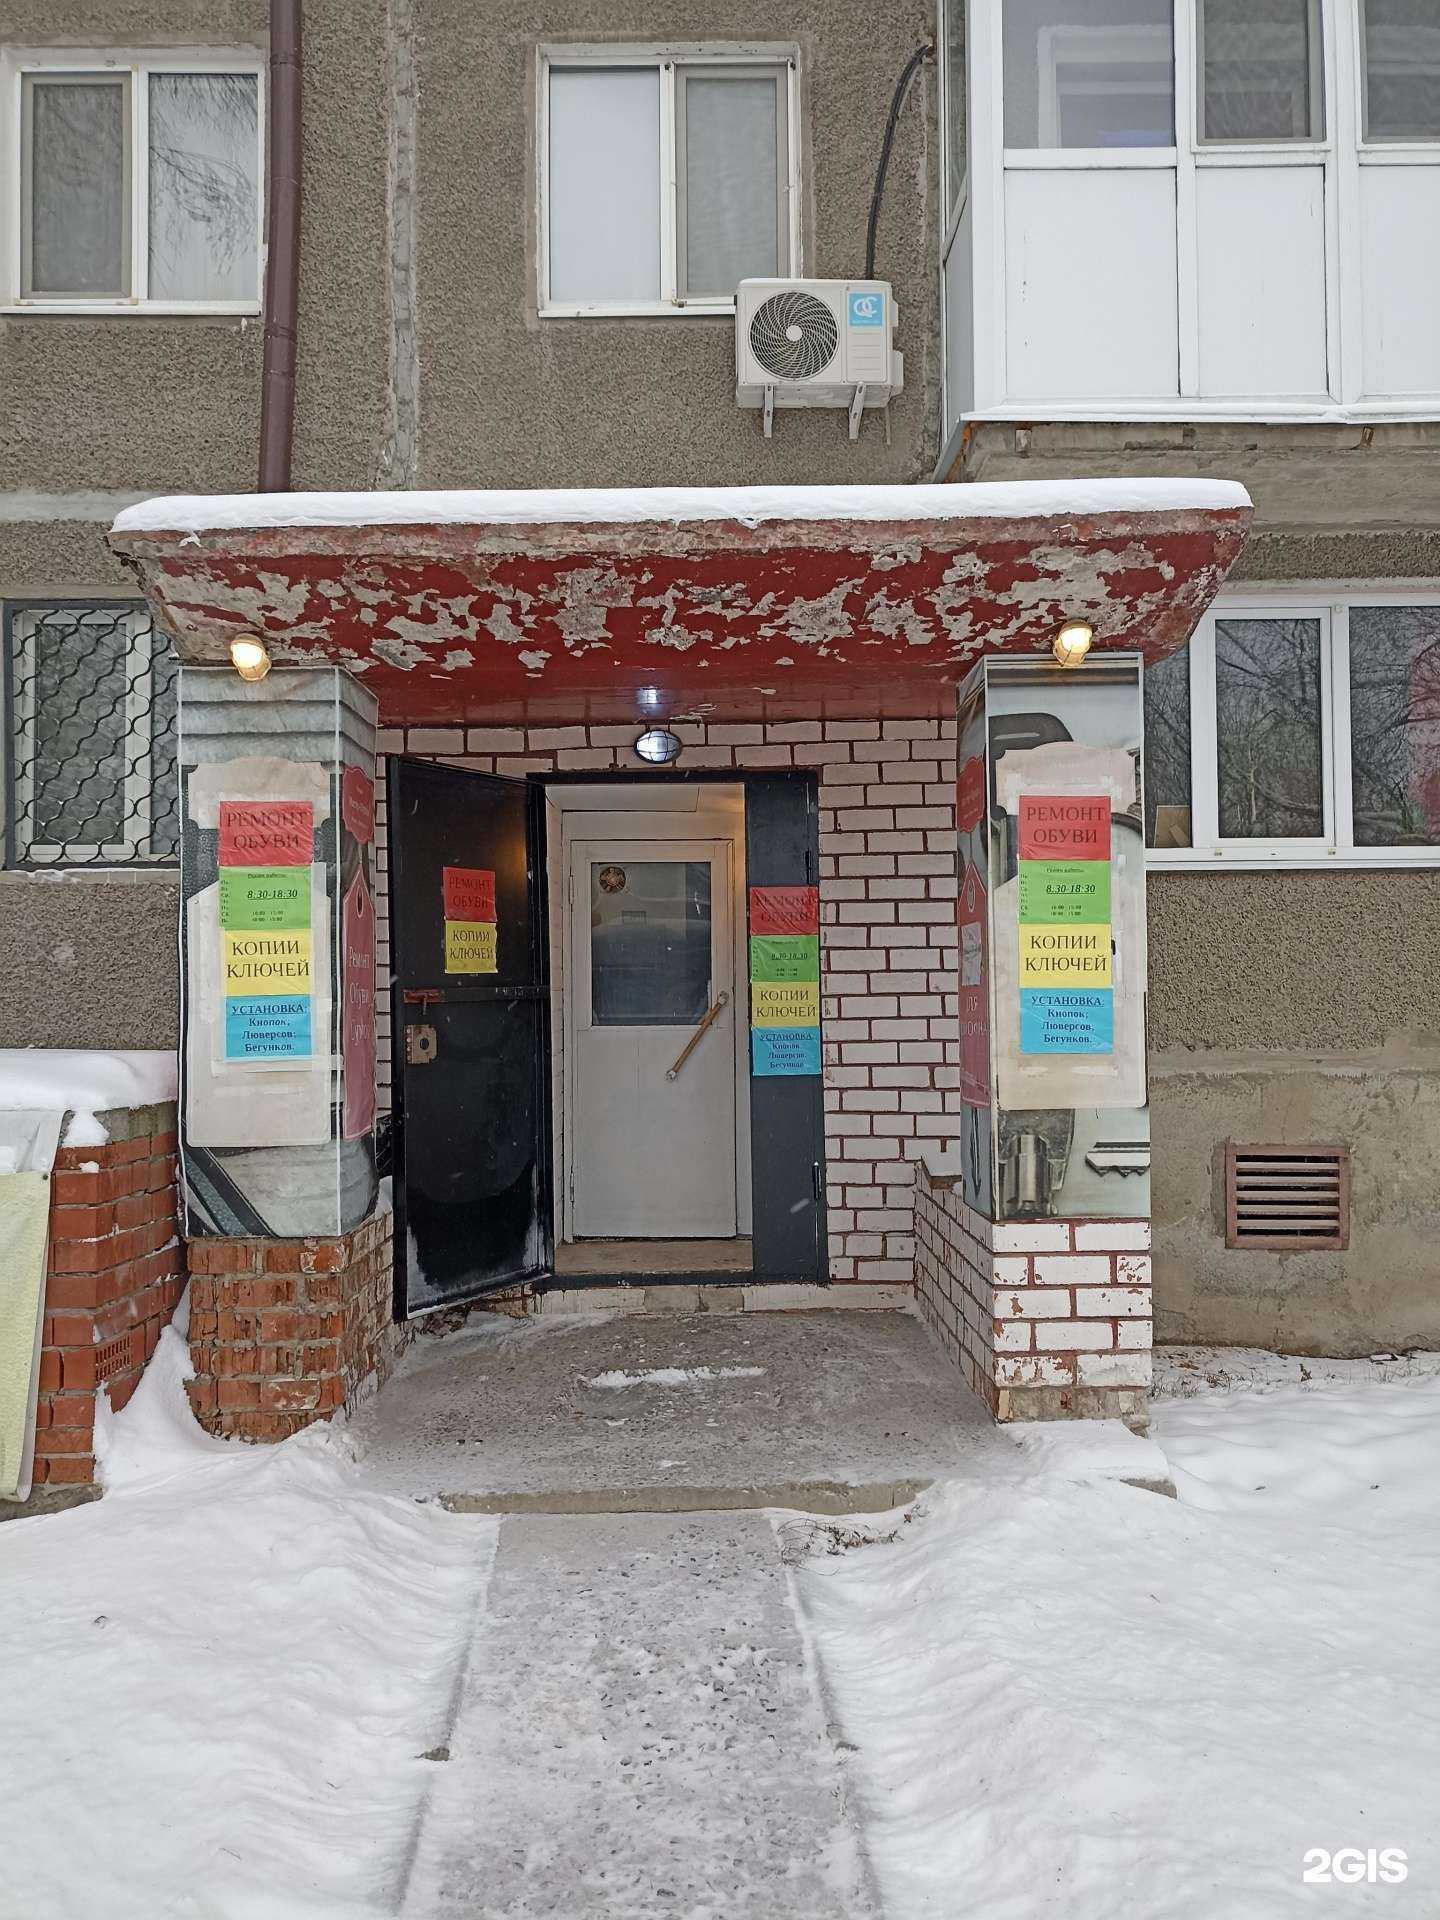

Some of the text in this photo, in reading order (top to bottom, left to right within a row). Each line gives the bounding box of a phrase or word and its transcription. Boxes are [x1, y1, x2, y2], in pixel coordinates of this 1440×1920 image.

[227, 810, 307, 827] РЕМОНТ
[1027, 806, 1105, 821] РЕМОНТ
[233, 833, 300, 849] ОБУВИ
[1033, 828, 1097, 844] ОБУВИ
[449, 877, 493, 890] РЕМОНТ
[1046, 884, 1096, 895] 8:30-18:30
[452, 895, 488, 908] ОБУВИ
[453, 930, 490, 942] КОПИИ
[1031, 935, 1097, 950] КОПИИ
[232, 940, 299, 956] КОПИИ
[227, 959, 310, 978] КЛЮЧЕЙ
[1025, 954, 1108, 972] КЛЮЧЕЙ
[760, 990, 809, 1001] КОПИИ
[756, 1004, 816, 1018] КЛЮЧЕЙ
